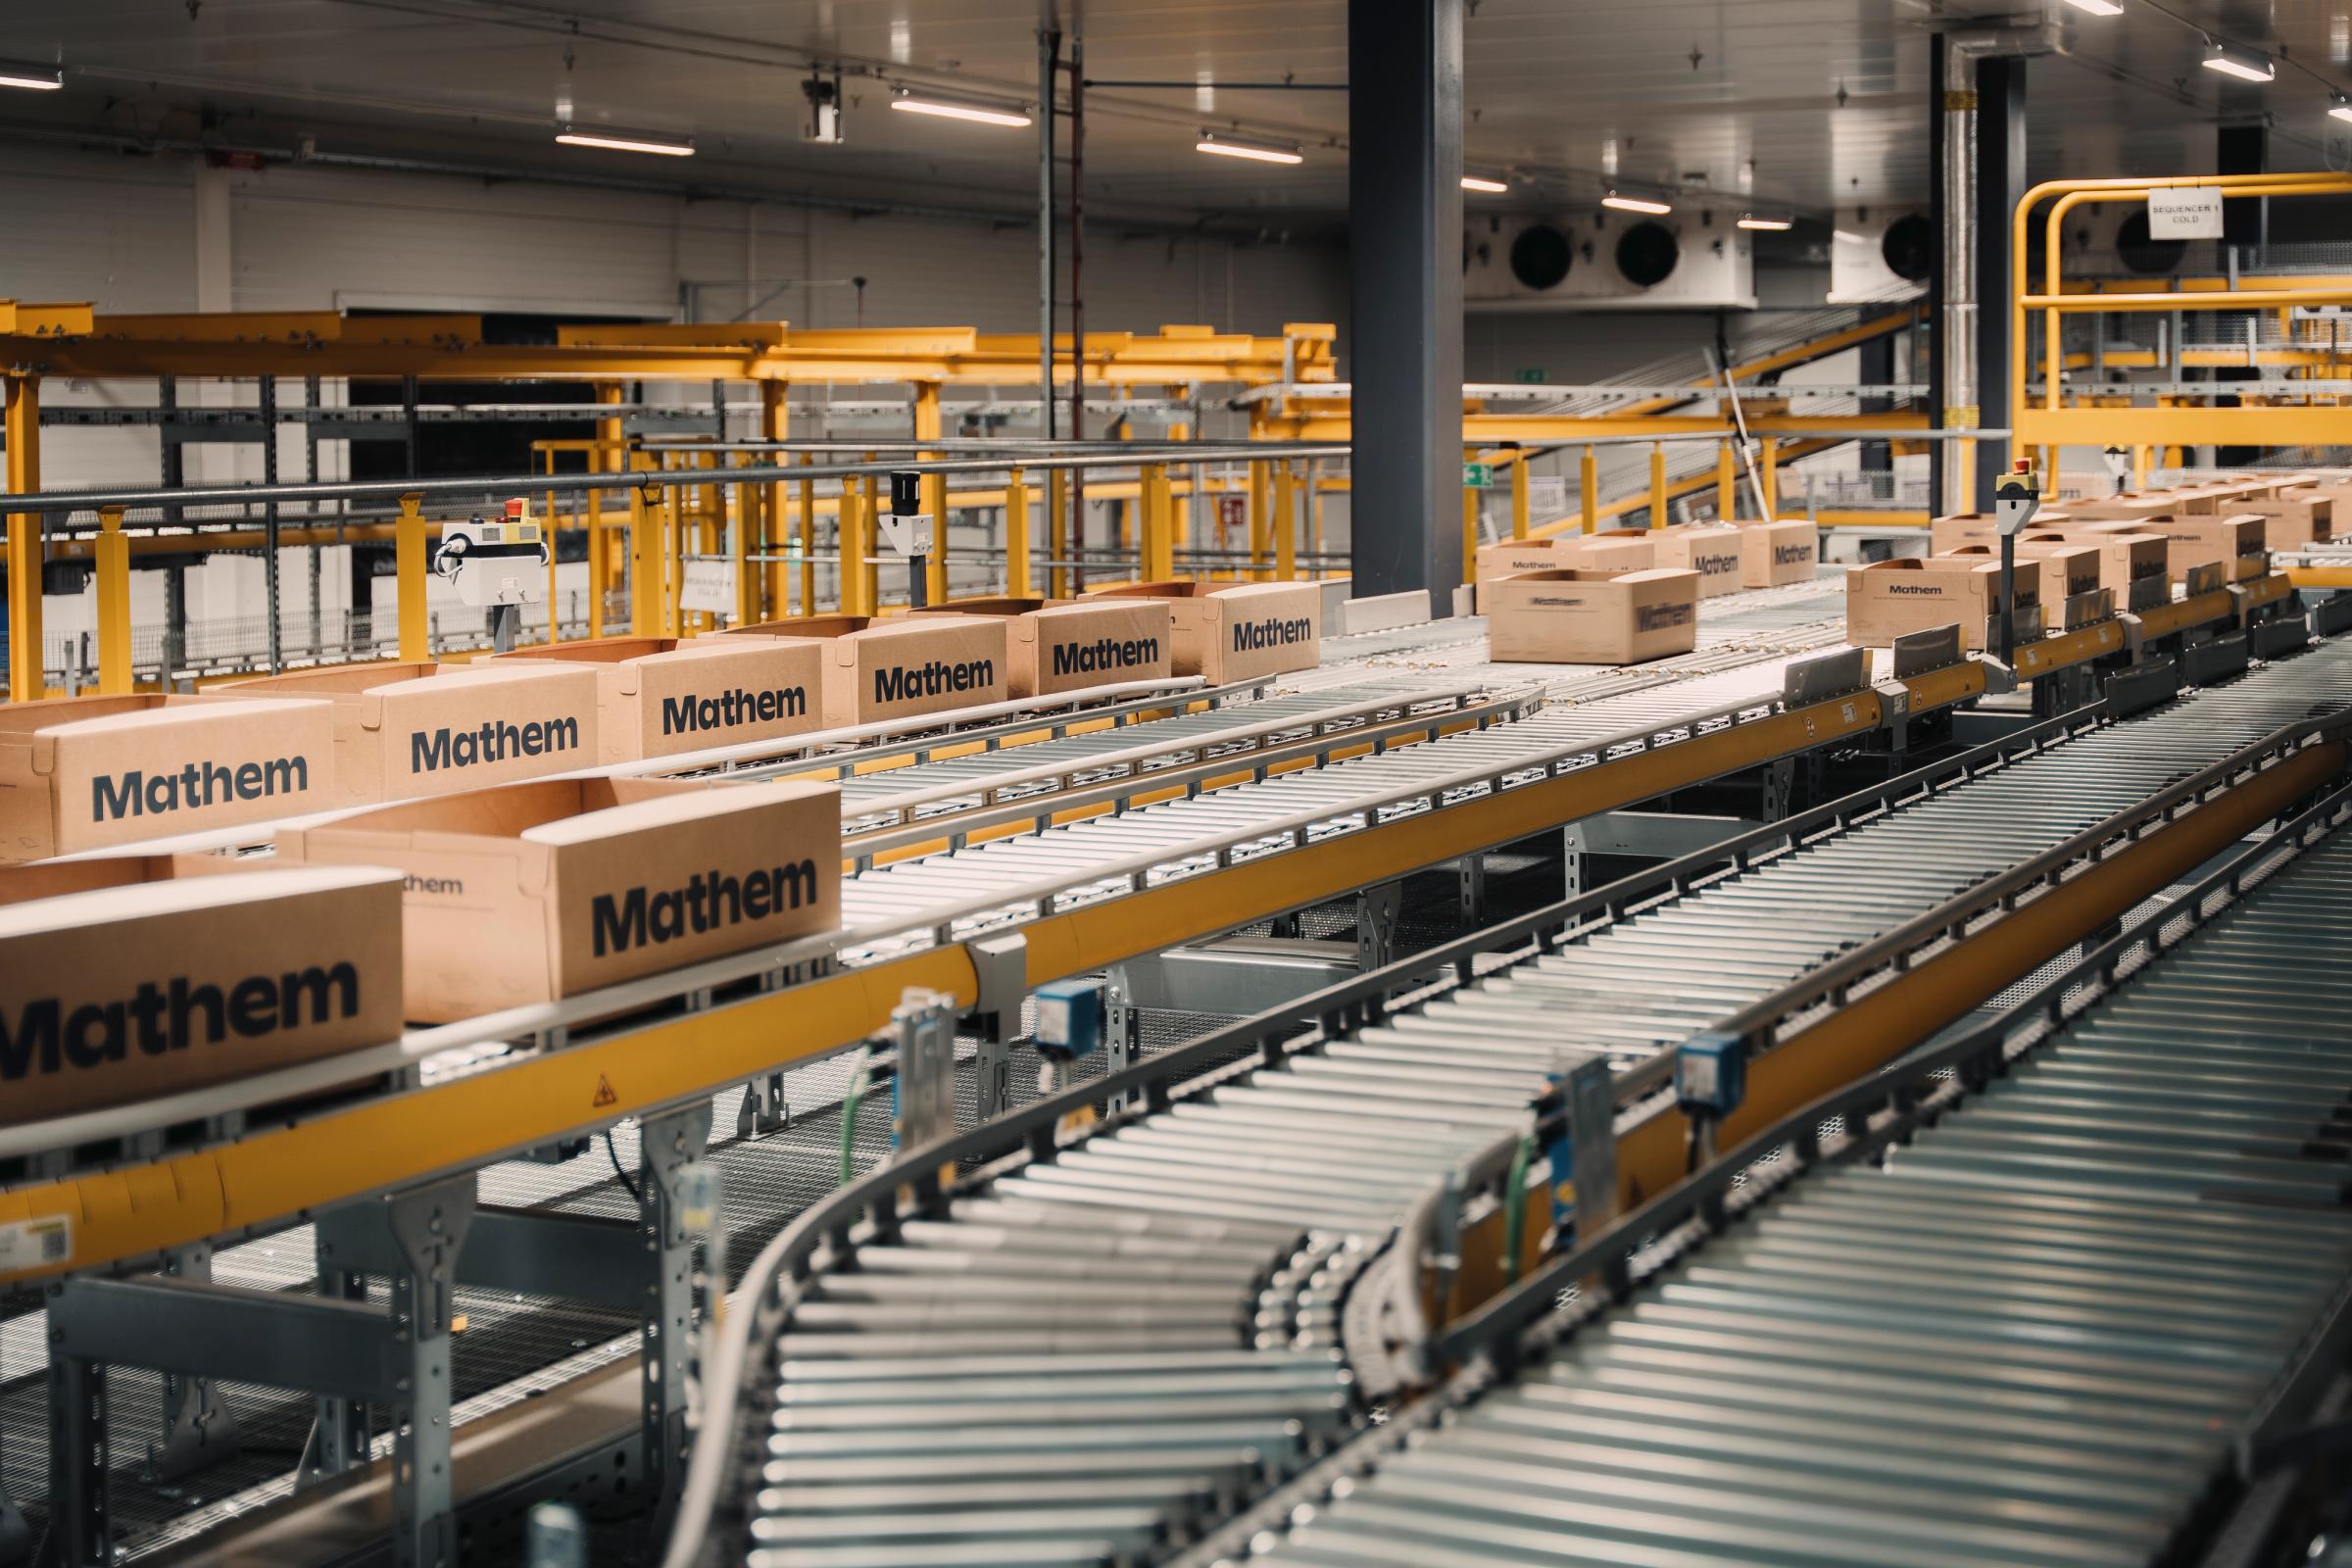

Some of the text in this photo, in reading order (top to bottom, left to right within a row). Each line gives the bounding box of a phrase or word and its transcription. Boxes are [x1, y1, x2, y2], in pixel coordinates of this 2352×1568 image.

[2152, 204, 2211, 214] SEQUENCER
[1694, 554, 1739, 576] Mathem
[1775, 545, 1812, 565] Mathem
[1888, 585, 1942, 595] Mathem
[1234, 617, 1311, 652] Mathem
[1054, 637, 1158, 676] Mathem
[875, 658, 994, 704] Mathem
[662, 686, 807, 735] Mathem
[412, 716, 578, 773] Mathem
[93, 755, 308, 822] Mathem
[402, 874, 464, 894] them
[592, 858, 816, 957] Mathem
[0, 961, 359, 1081] Mathem
